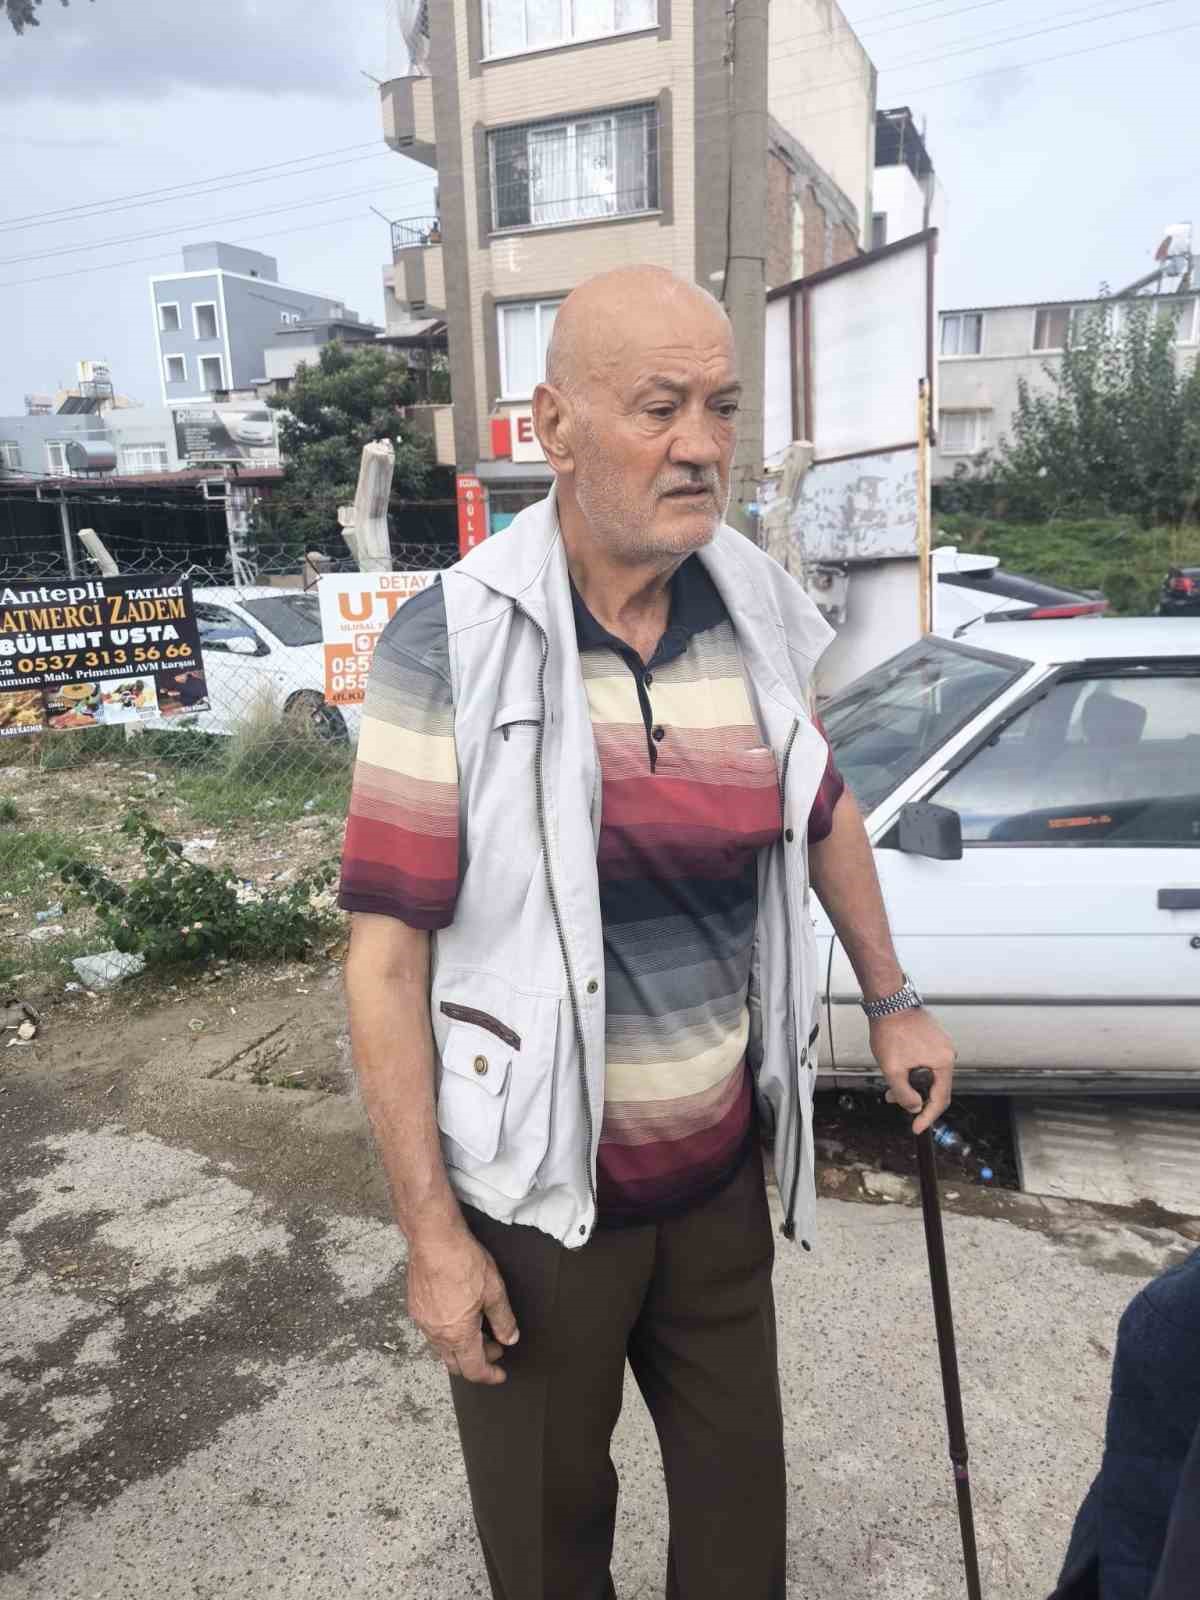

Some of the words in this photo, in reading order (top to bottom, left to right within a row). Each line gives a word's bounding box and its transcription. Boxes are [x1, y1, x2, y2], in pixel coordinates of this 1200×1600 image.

[0, 581, 106, 606] Antepli
[125, 586, 184, 601] TATLICI
[379, 575, 428, 590] DETAY
[0, 600, 103, 634] ATMERCİ
[337, 591, 418, 622] UT
[0, 631, 104, 657] BÜLENT
[110, 624, 180, 646] USTA
[18, 653, 78, 673] 0537
[85, 649, 128, 668] 313
[134, 646, 161, 662] 56
[165, 642, 193, 658] 66
[43, 671, 73, 683] Mah.
[76, 664, 134, 679] Primemall
[135, 662, 159, 673] AVM
